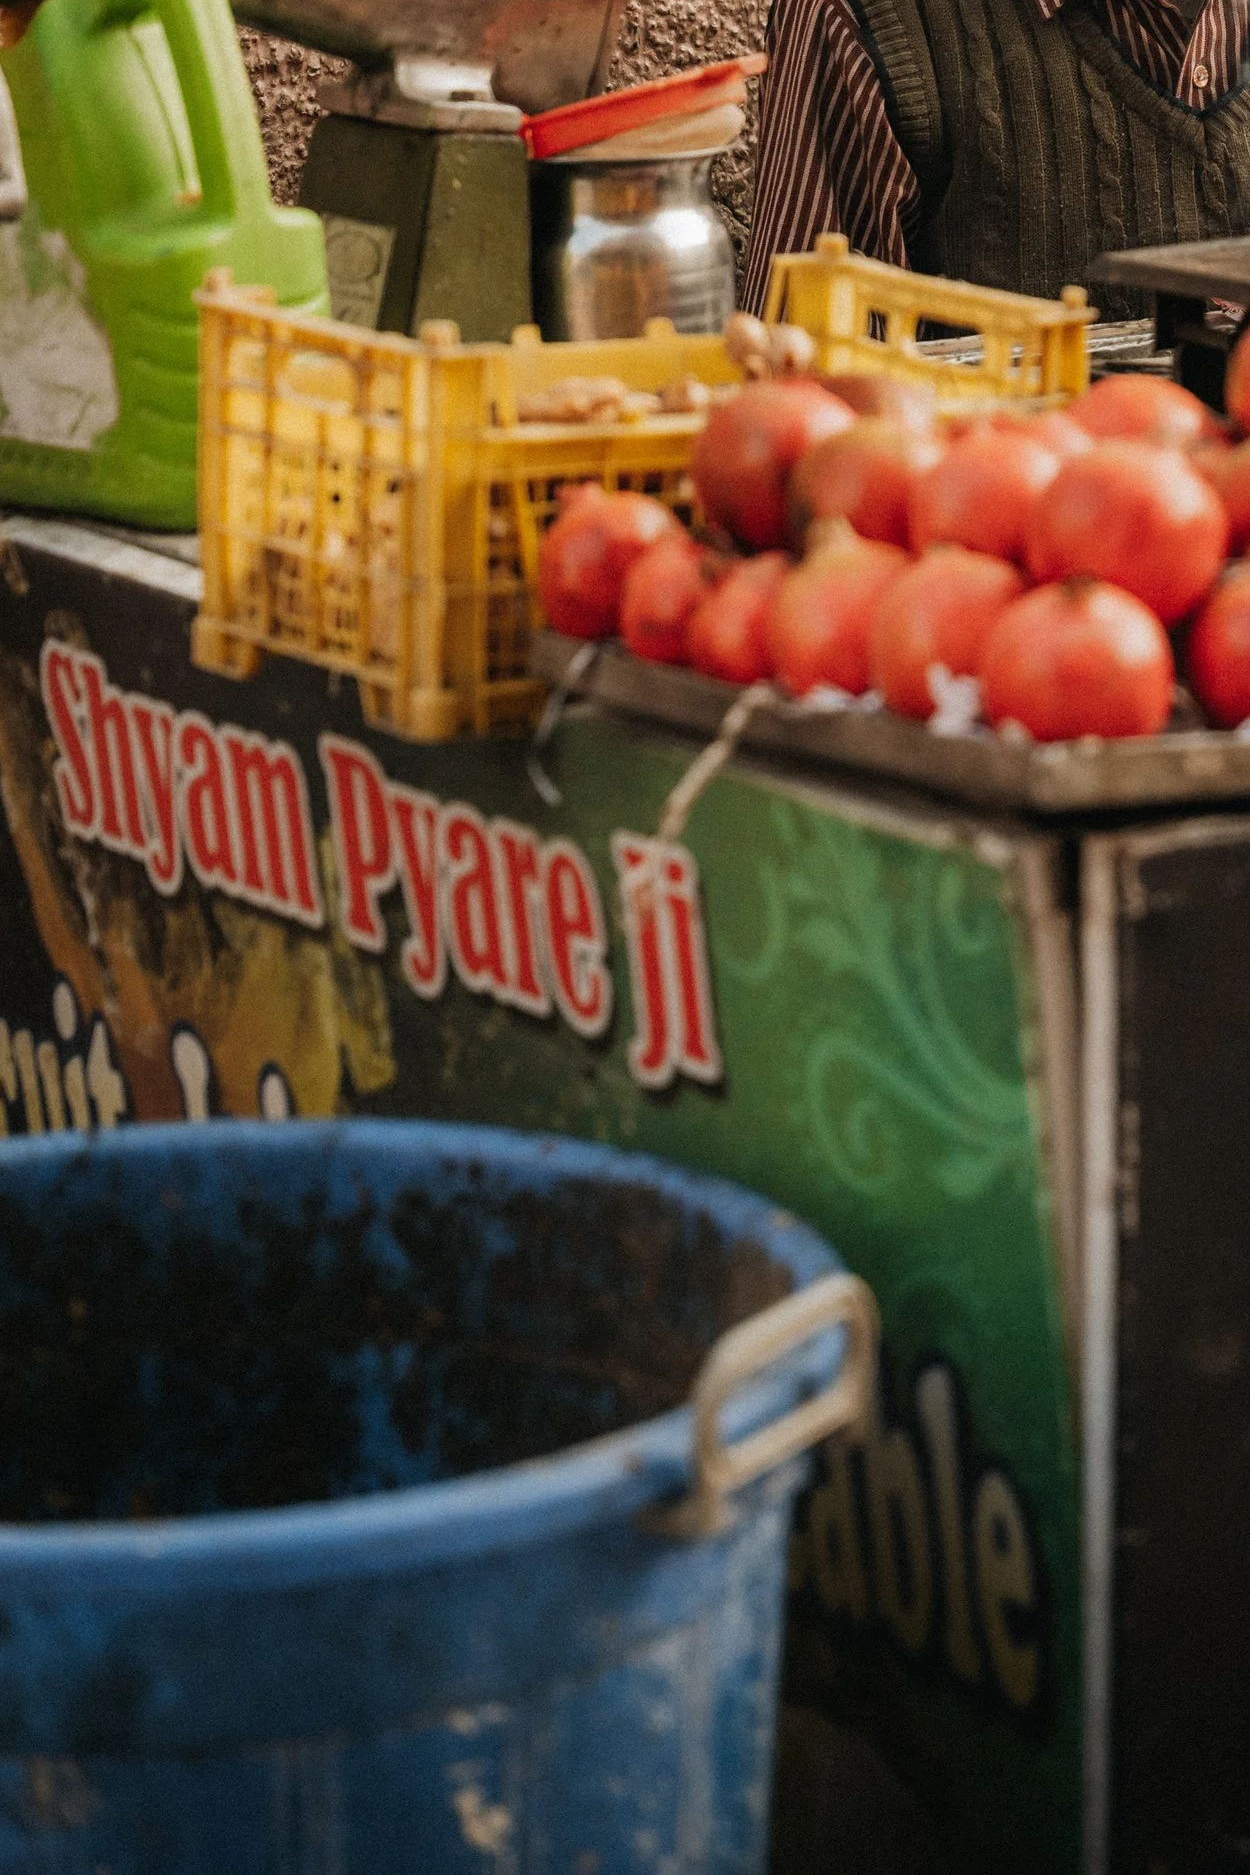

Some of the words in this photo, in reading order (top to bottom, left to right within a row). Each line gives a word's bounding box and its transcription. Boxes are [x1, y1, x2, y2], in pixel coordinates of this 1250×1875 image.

[41, 639, 325, 926] Shyam
[318, 733, 612, 1039] Pyare
[611, 829, 723, 1087] ji
